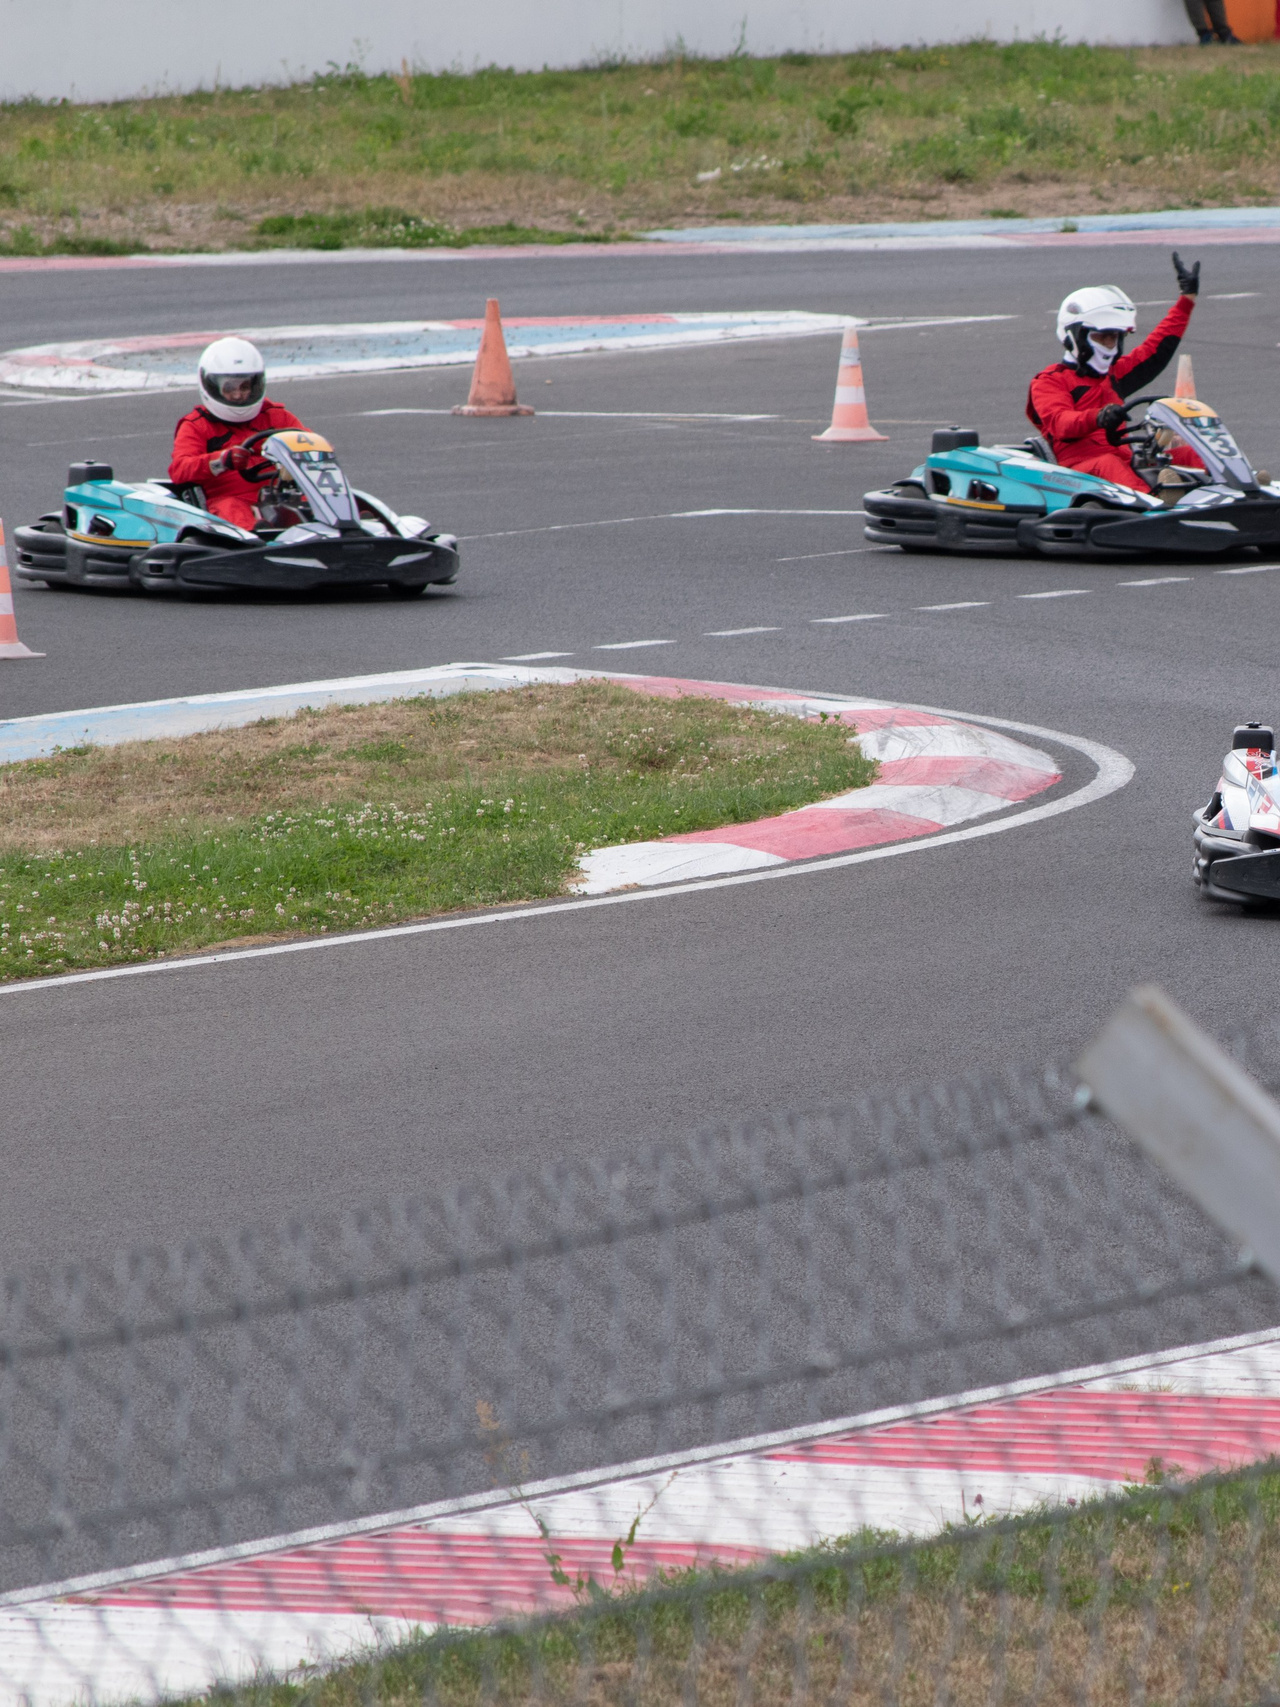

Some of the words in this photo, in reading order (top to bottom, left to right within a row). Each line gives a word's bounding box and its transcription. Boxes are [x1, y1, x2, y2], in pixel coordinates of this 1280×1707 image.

[297, 434, 314, 445] 4
[1209, 433, 1238, 456] 3
[316, 471, 343, 493] 4
